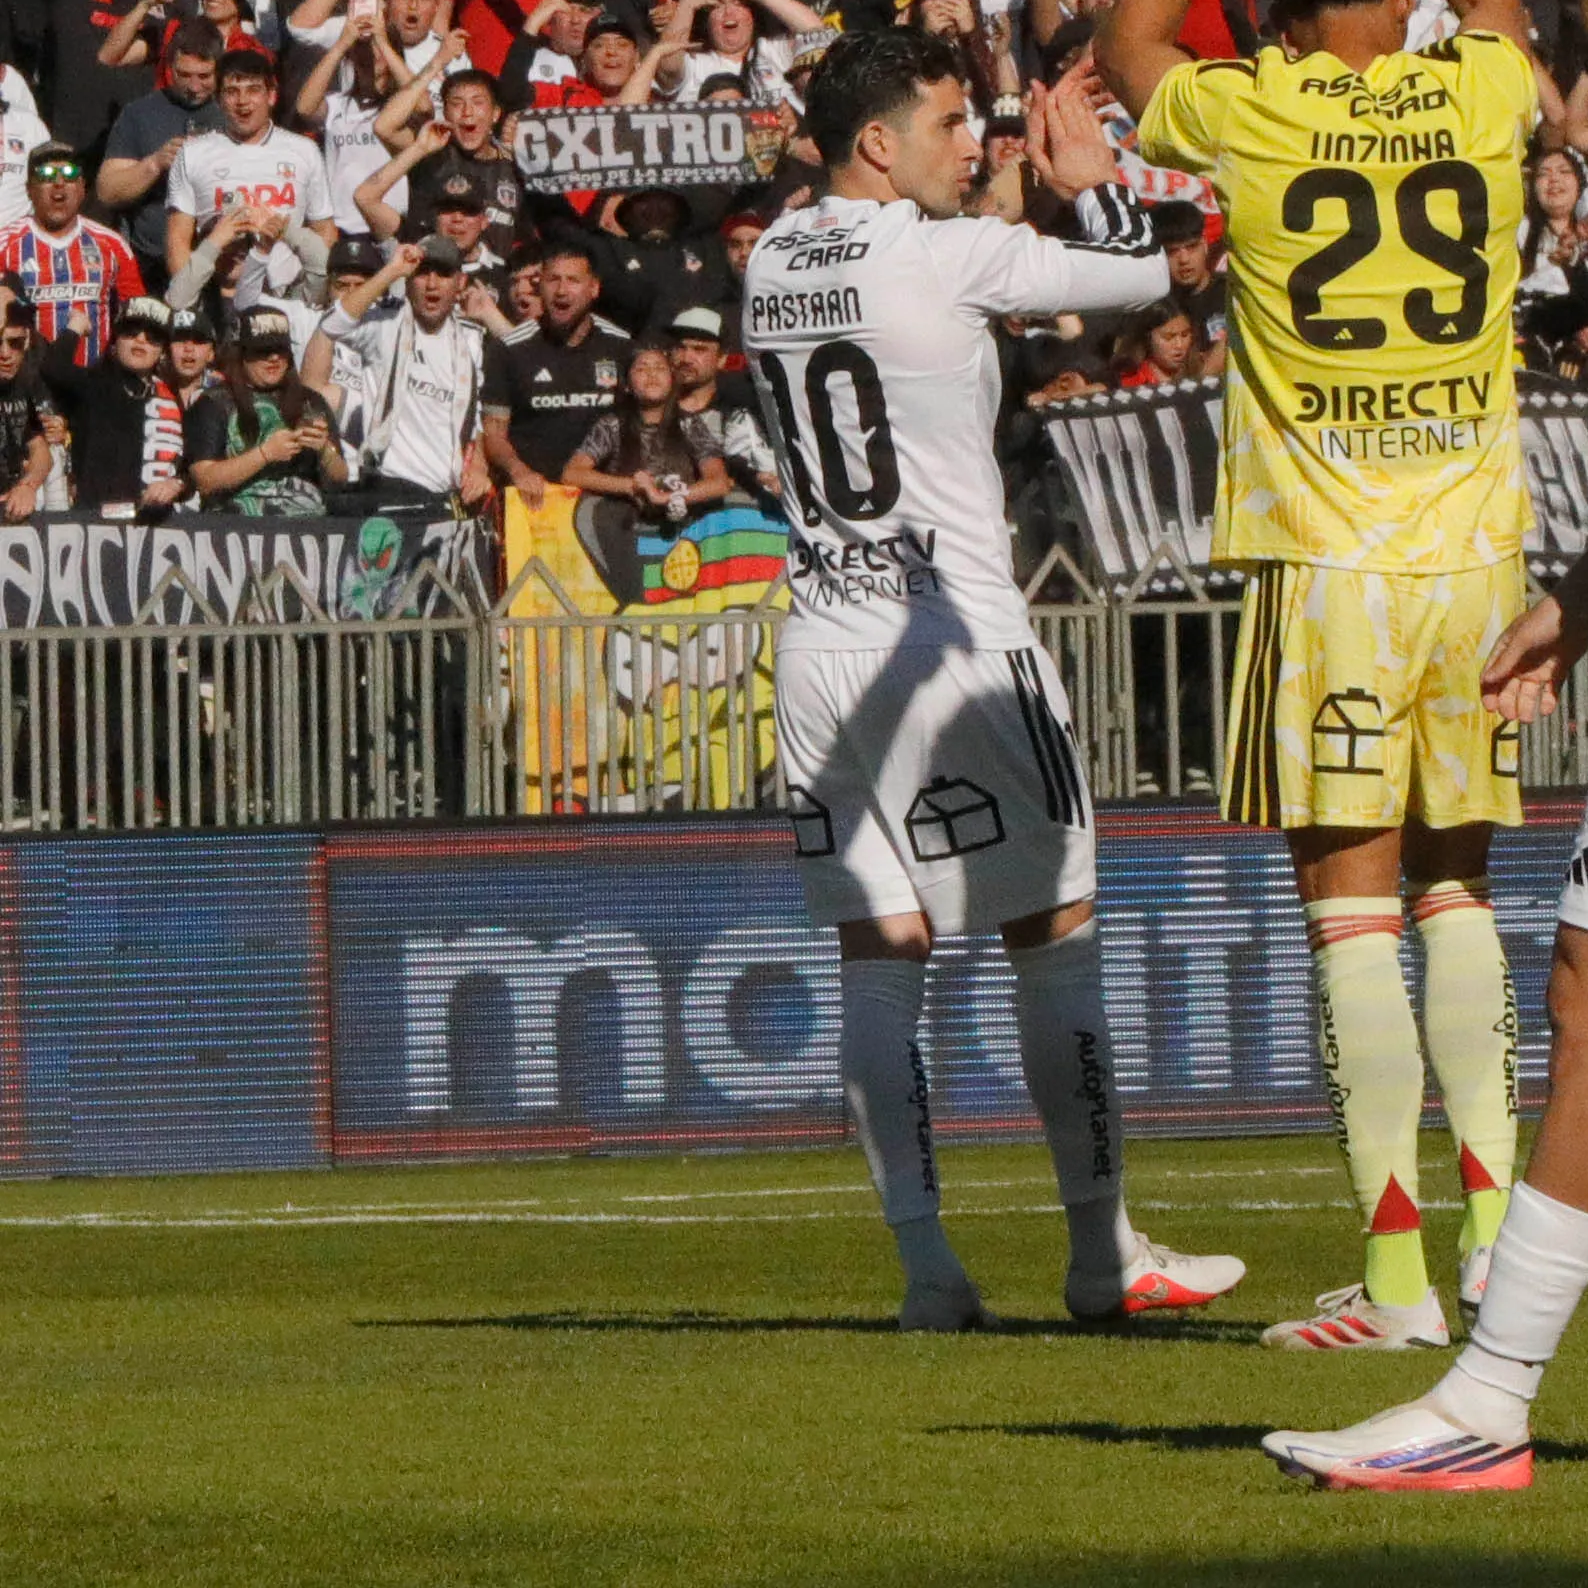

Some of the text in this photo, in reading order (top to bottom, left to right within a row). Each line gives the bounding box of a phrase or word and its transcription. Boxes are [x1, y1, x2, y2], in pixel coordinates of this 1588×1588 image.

[513, 111, 746, 176] GXLTRO
[1282, 159, 1492, 351] 29
[531, 392, 598, 408] COOLBET
[1292, 370, 1492, 424] DIRECTV
[758, 339, 902, 528] 10
[1317, 417, 1487, 460] INTERNET
